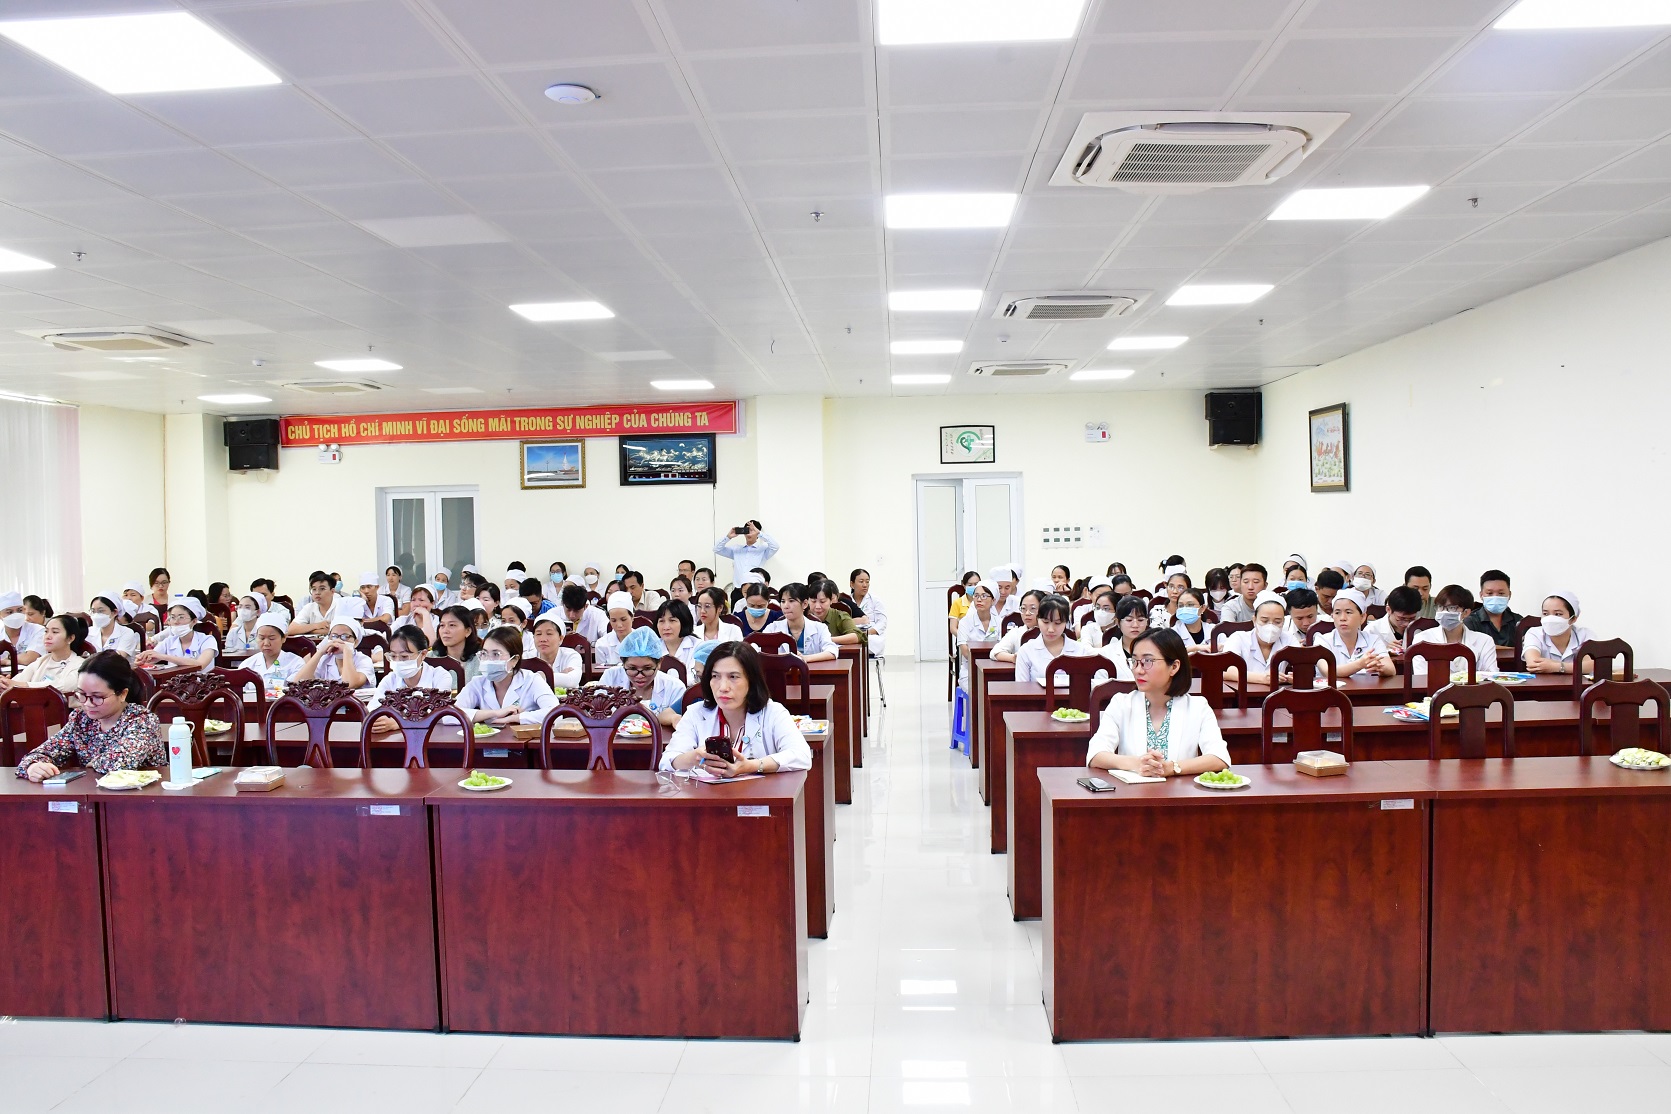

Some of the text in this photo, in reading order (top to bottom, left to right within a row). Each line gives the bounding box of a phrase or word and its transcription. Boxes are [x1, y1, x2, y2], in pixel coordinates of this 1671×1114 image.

[288, 421, 310, 439] CHỦ
[313, 423, 338, 441] TỊCH
[360, 419, 379, 436] CHÍ
[382, 421, 412, 435] MINH
[416, 418, 427, 434] VĨ
[430, 420, 449, 436] ĐẠI
[453, 414, 485, 433] SỐNG
[488, 415, 511, 431] MÃI
[514, 416, 553, 430] TRONG
[556, 415, 573, 432] SỰ
[576, 412, 619, 431] NGHIỆP
[623, 409, 647, 428] CỦA
[651, 410, 692, 427] CHÚNG
[695, 412, 709, 426] TA
